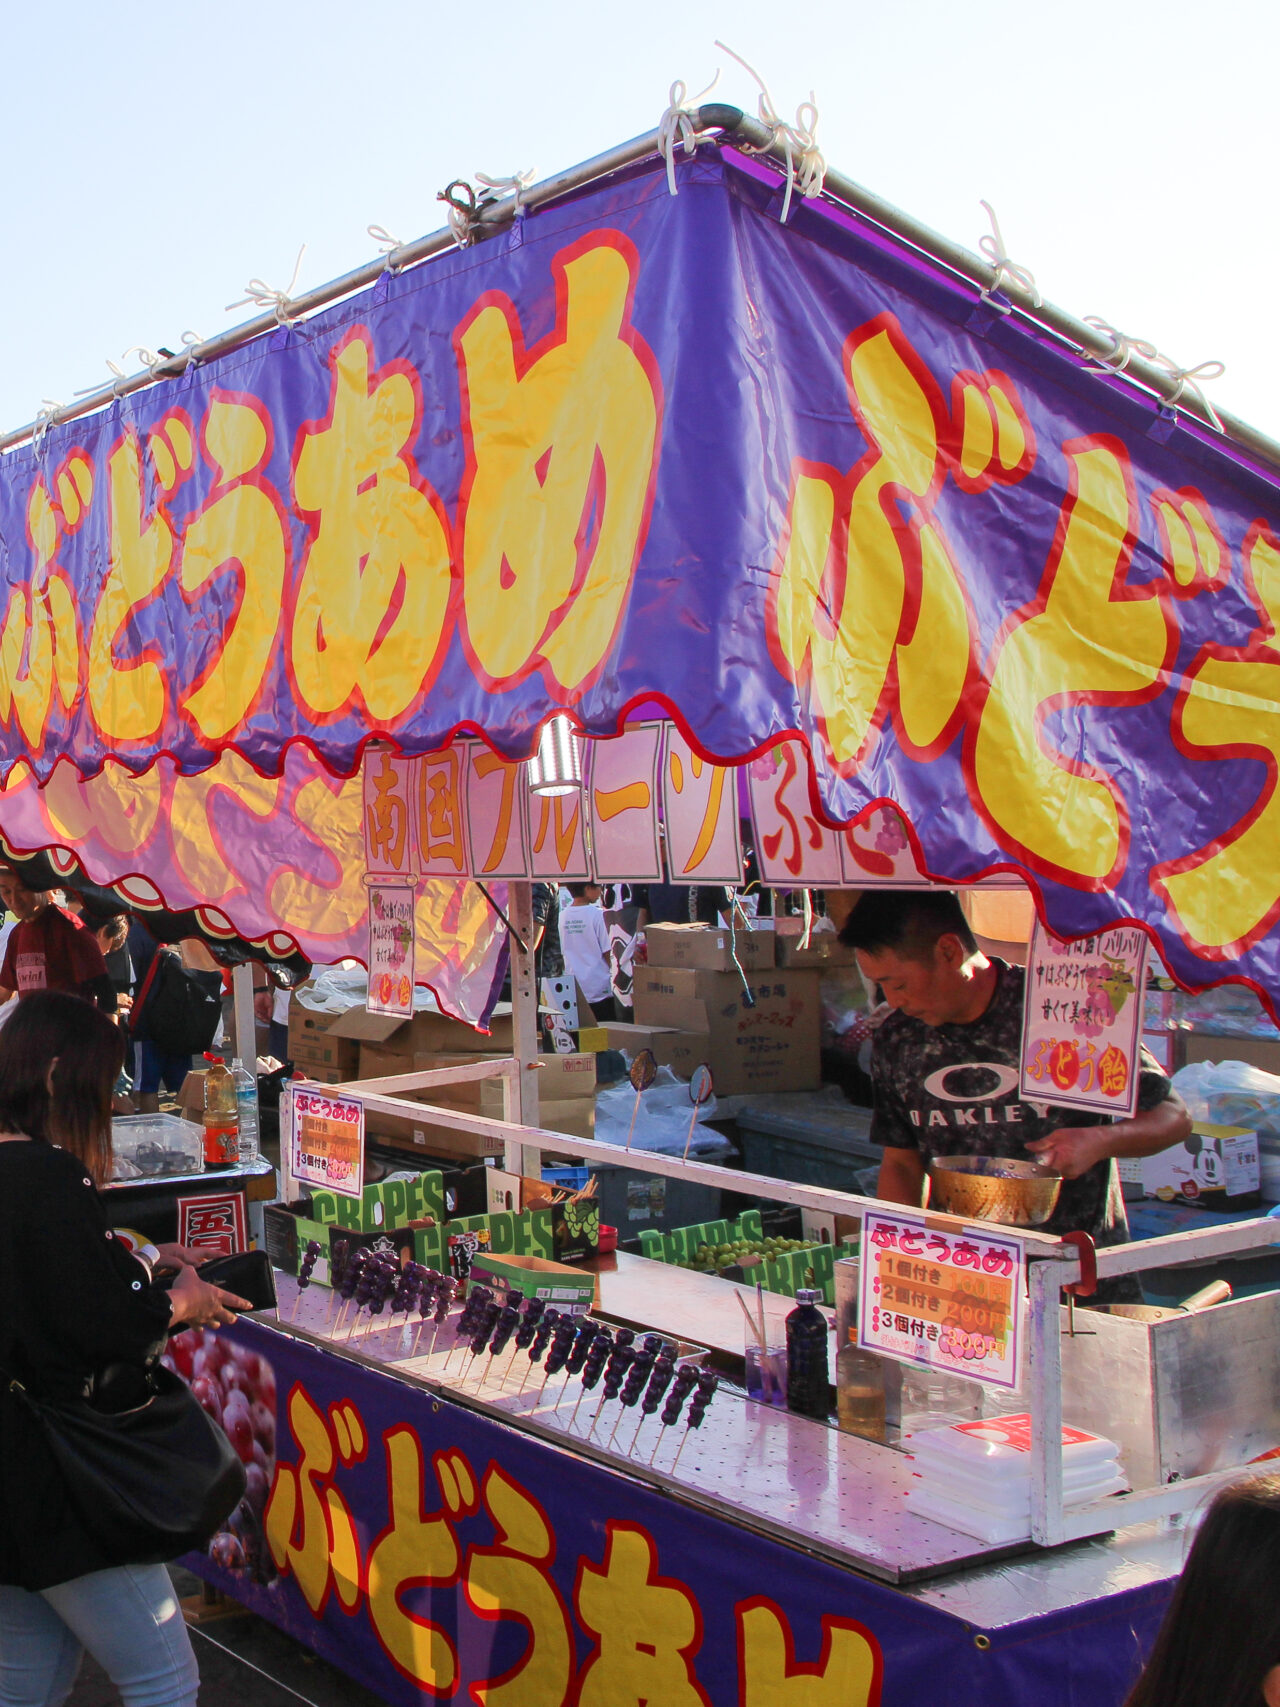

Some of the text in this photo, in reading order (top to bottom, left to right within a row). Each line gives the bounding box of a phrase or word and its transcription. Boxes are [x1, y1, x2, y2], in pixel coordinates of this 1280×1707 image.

[1026, 1037, 1126, 1093] ぶどう飴
[296, 1094, 360, 1123] ぶどうあめ
[909, 1103, 1051, 1128] OAKLEY
[301, 1153, 327, 1170] 3個付き
[870, 1223, 1014, 1277] ぶどうあめ
[885, 1258, 942, 1285] 1個付き
[882, 1284, 1006, 1331] 2個付き 200円
[881, 1312, 939, 1342] 3個付き
[946, 1329, 1006, 1361] 300円
